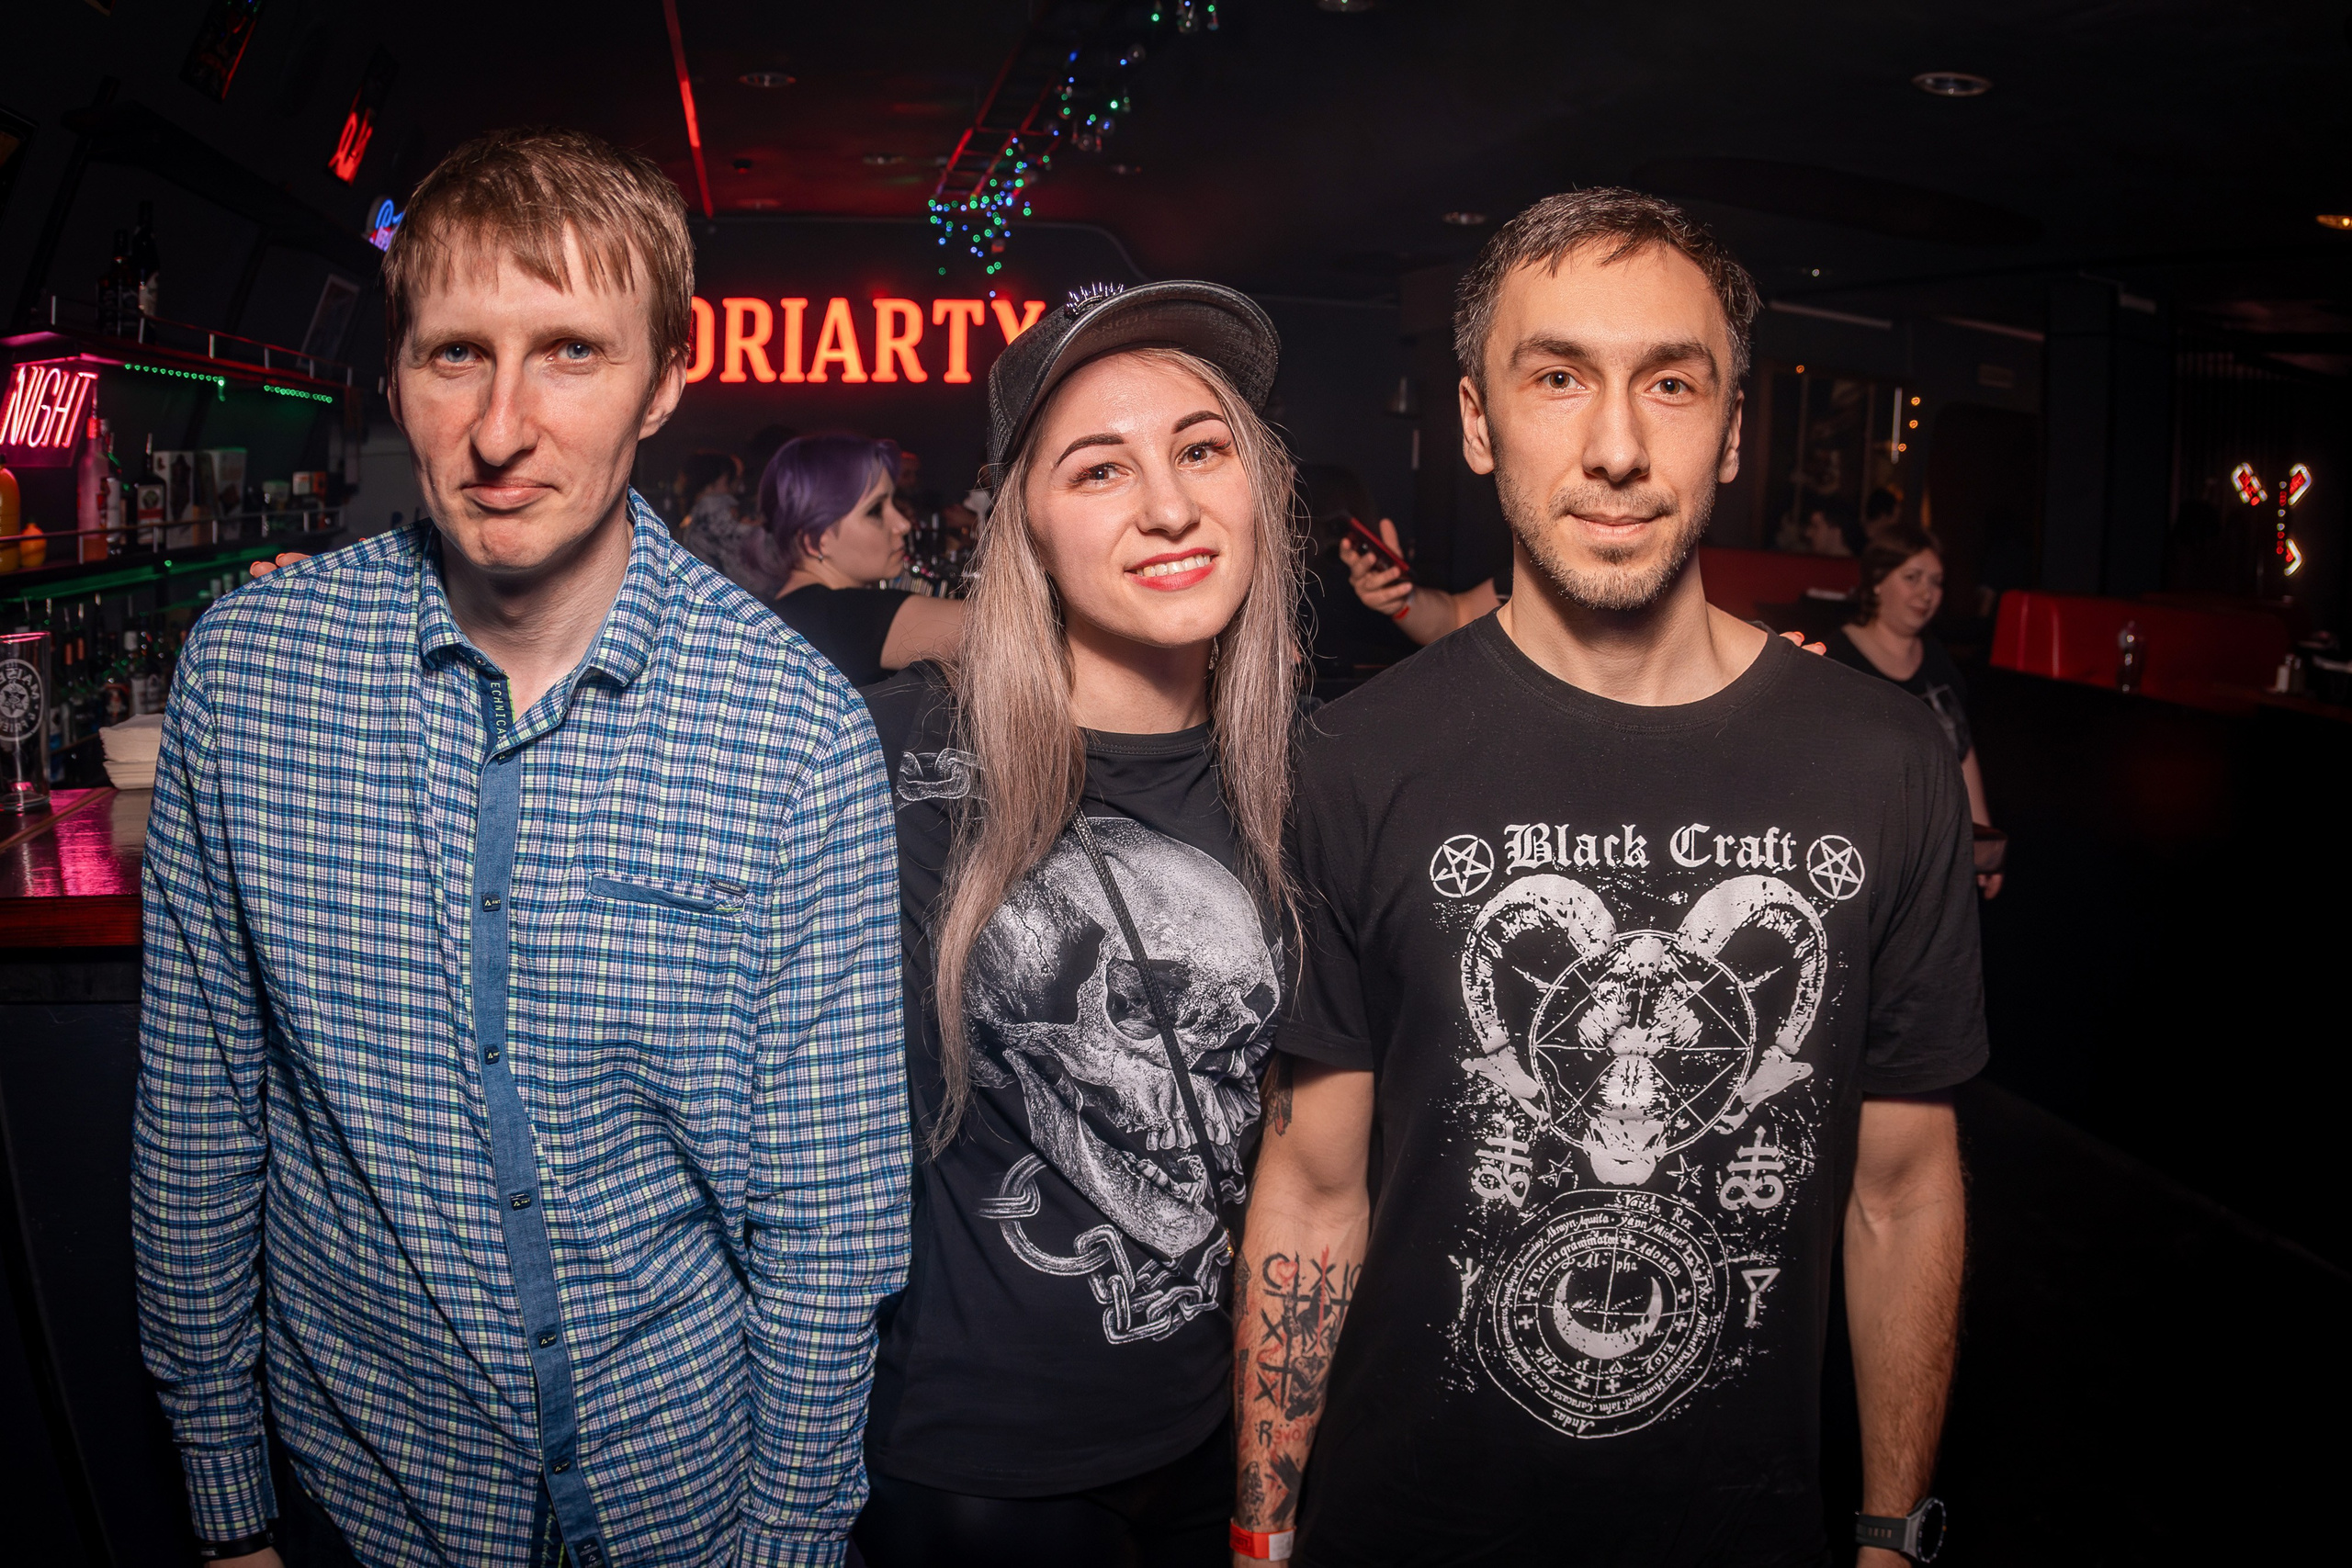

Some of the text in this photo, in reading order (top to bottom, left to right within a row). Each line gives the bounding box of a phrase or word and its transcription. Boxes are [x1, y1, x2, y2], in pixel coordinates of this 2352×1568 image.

[0, 366, 98, 447] NIGHT
[491, 678, 507, 741] ECHNICA
[1504, 823, 1797, 872] Black Craft
[1671, 1206, 1694, 1229] Rex
[1552, 1409, 1595, 1434] Andas
